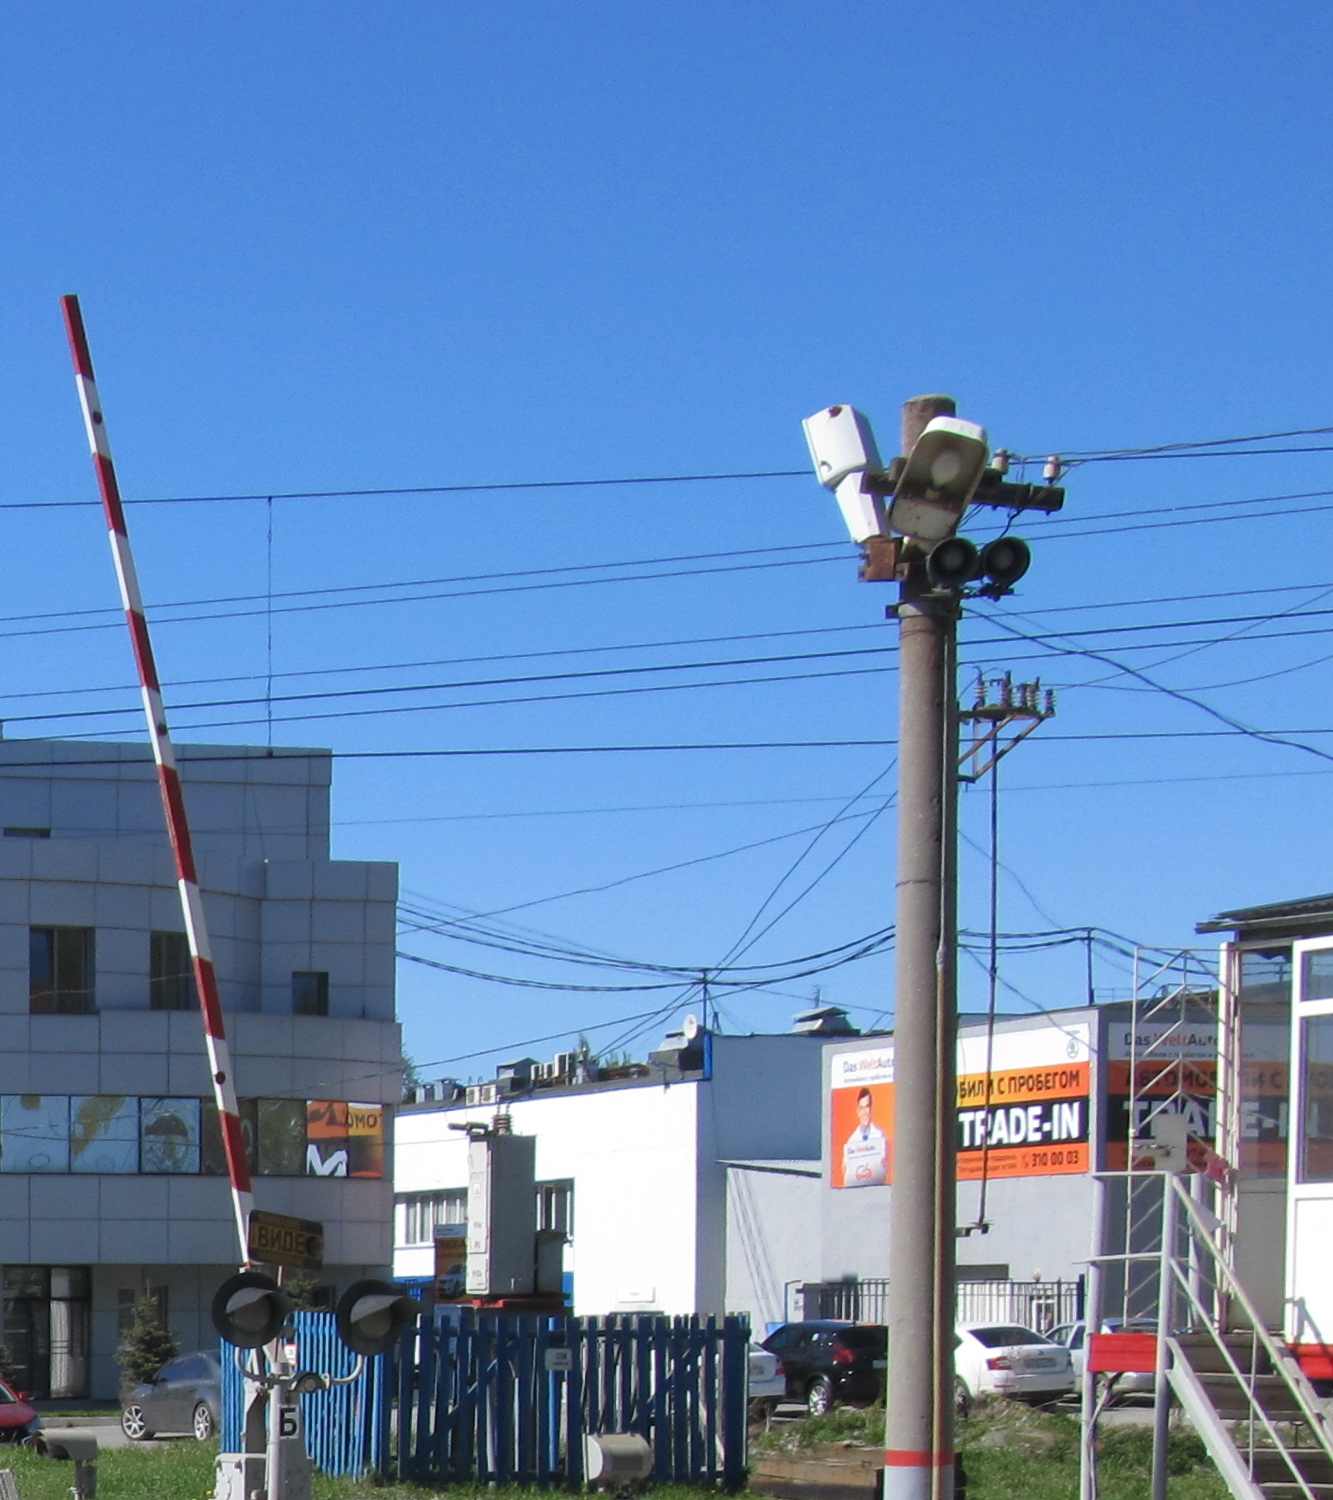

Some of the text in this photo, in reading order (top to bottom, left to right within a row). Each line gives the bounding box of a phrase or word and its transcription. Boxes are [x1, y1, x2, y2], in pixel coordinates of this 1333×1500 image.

[1007, 1069, 1081, 1095] ПРОБЕГОМ
[958, 1101, 1081, 1147] TRADE-IN
[280, 1407, 298, 1436] Б
